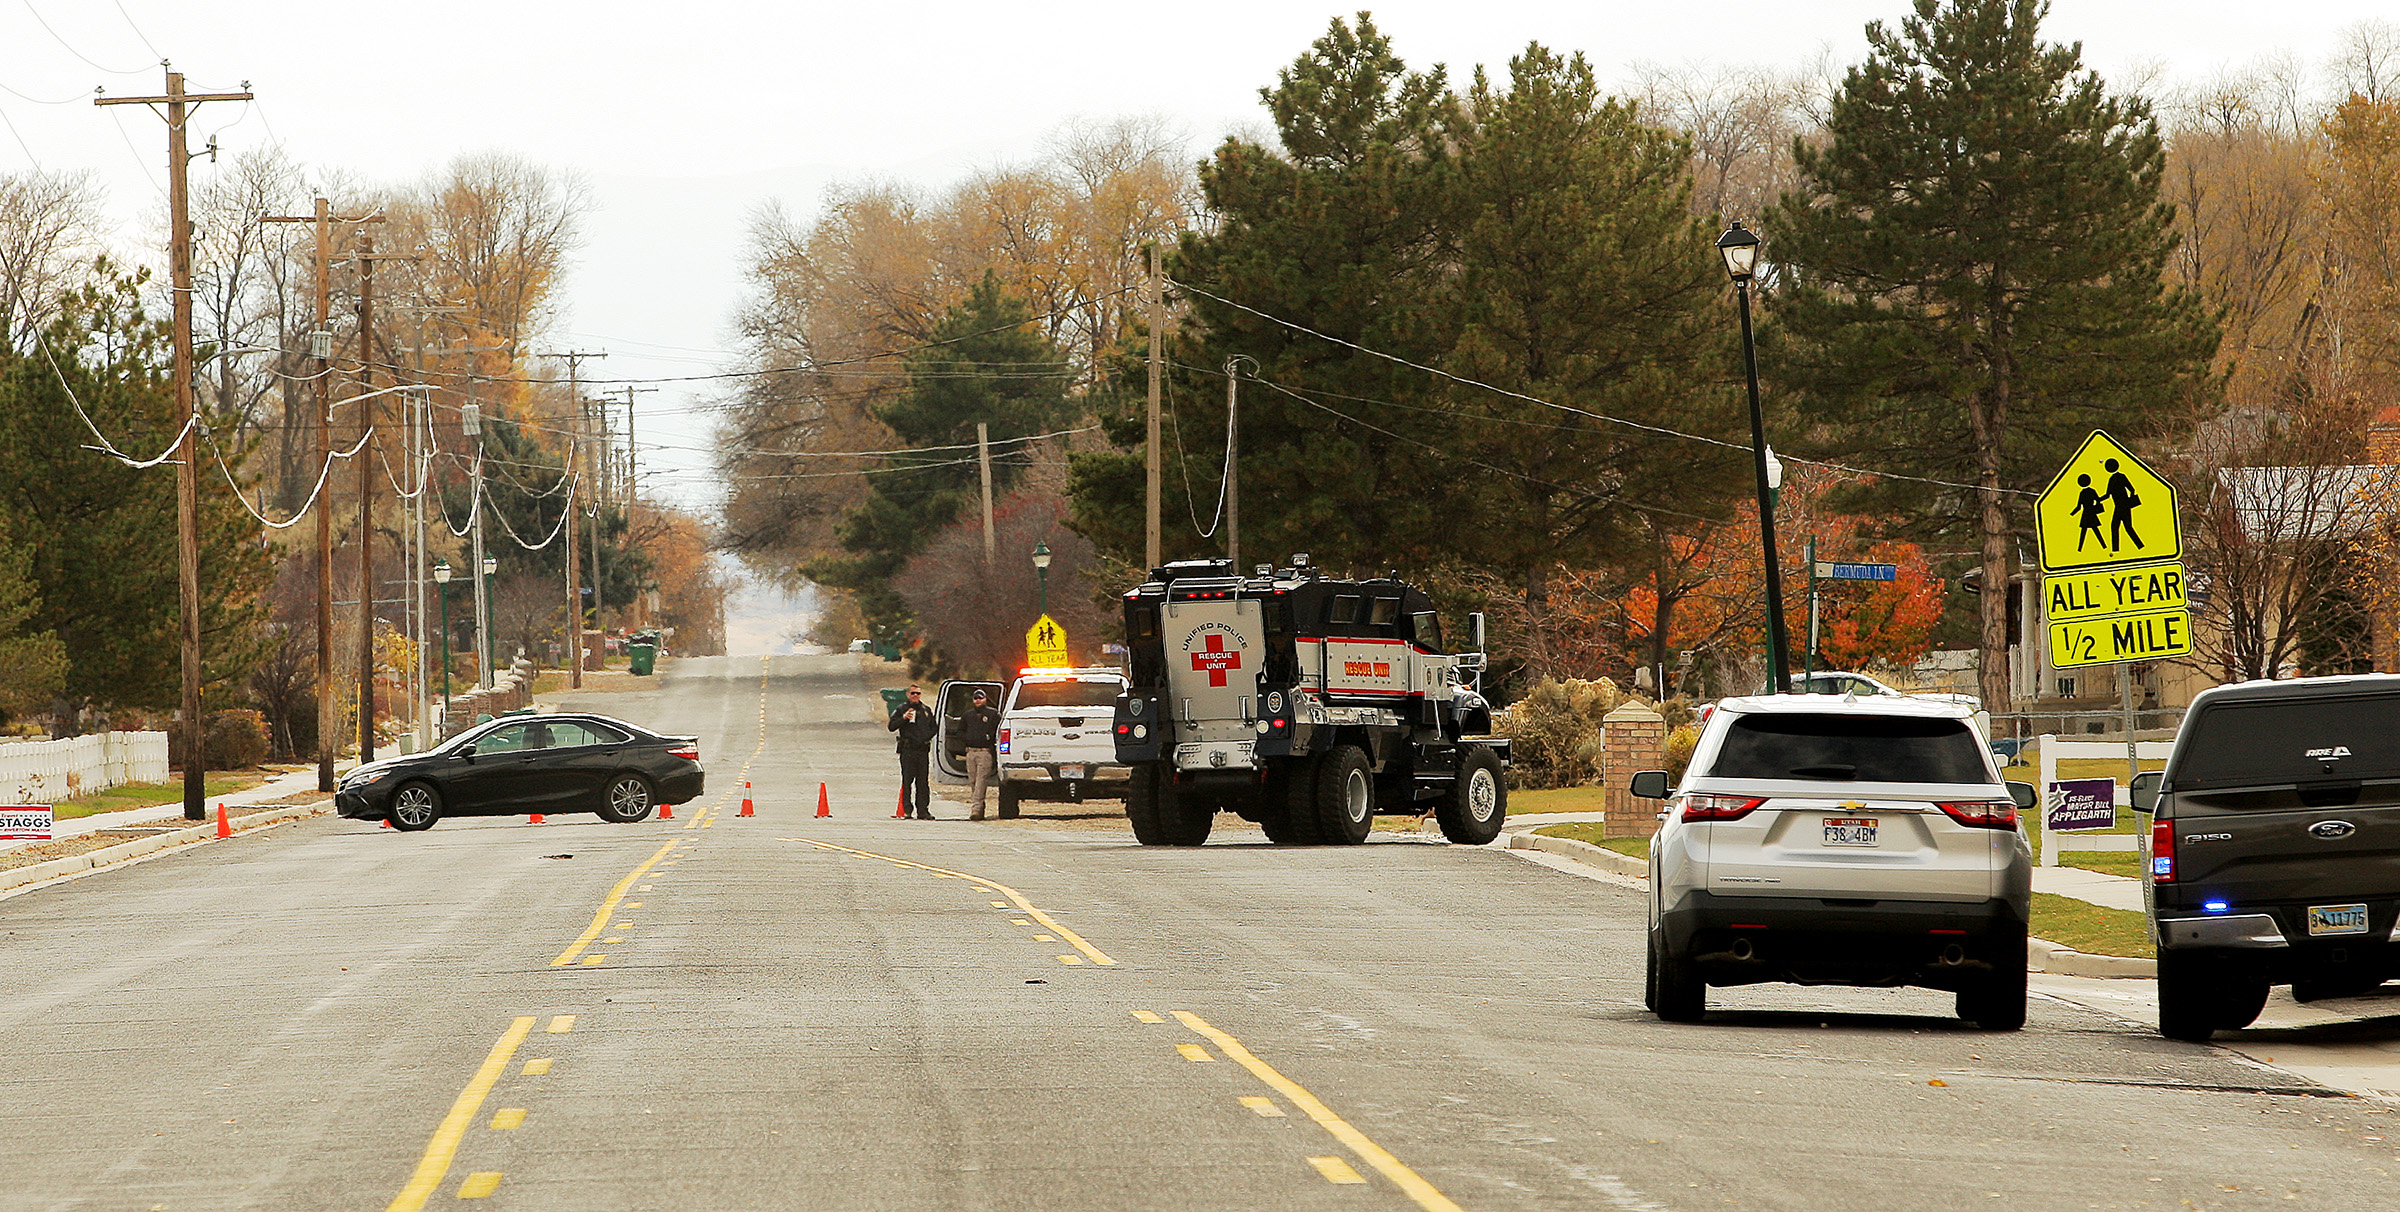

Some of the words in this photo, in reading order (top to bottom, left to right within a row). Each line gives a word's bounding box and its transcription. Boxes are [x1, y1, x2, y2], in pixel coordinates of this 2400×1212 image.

[1834, 564, 1872, 579] BERMUDA
[1874, 566, 1885, 580] LN
[2051, 581, 2100, 613] ALL
[2110, 572, 2181, 606] YEAR
[1182, 622, 1214, 652] UNIFIED
[1217, 622, 1248, 650] POLICE
[2062, 627, 2097, 660] 1/2
[2112, 617, 2183, 655] MILE
[1198, 652, 1233, 660] RESCUE
[1206, 662, 1227, 670] UNIT
[1344, 661, 1373, 677] RESCUE
[1373, 662, 1390, 678] UNIT
[2066, 801, 2094, 811] MAYOR
[2094, 800, 2111, 810] BILL
[0, 818, 51, 828] STAGGS
[2050, 809, 2112, 823] APPLEGARTH
[1824, 827, 1846, 841] F38
[2330, 911, 2365, 927] 11775
